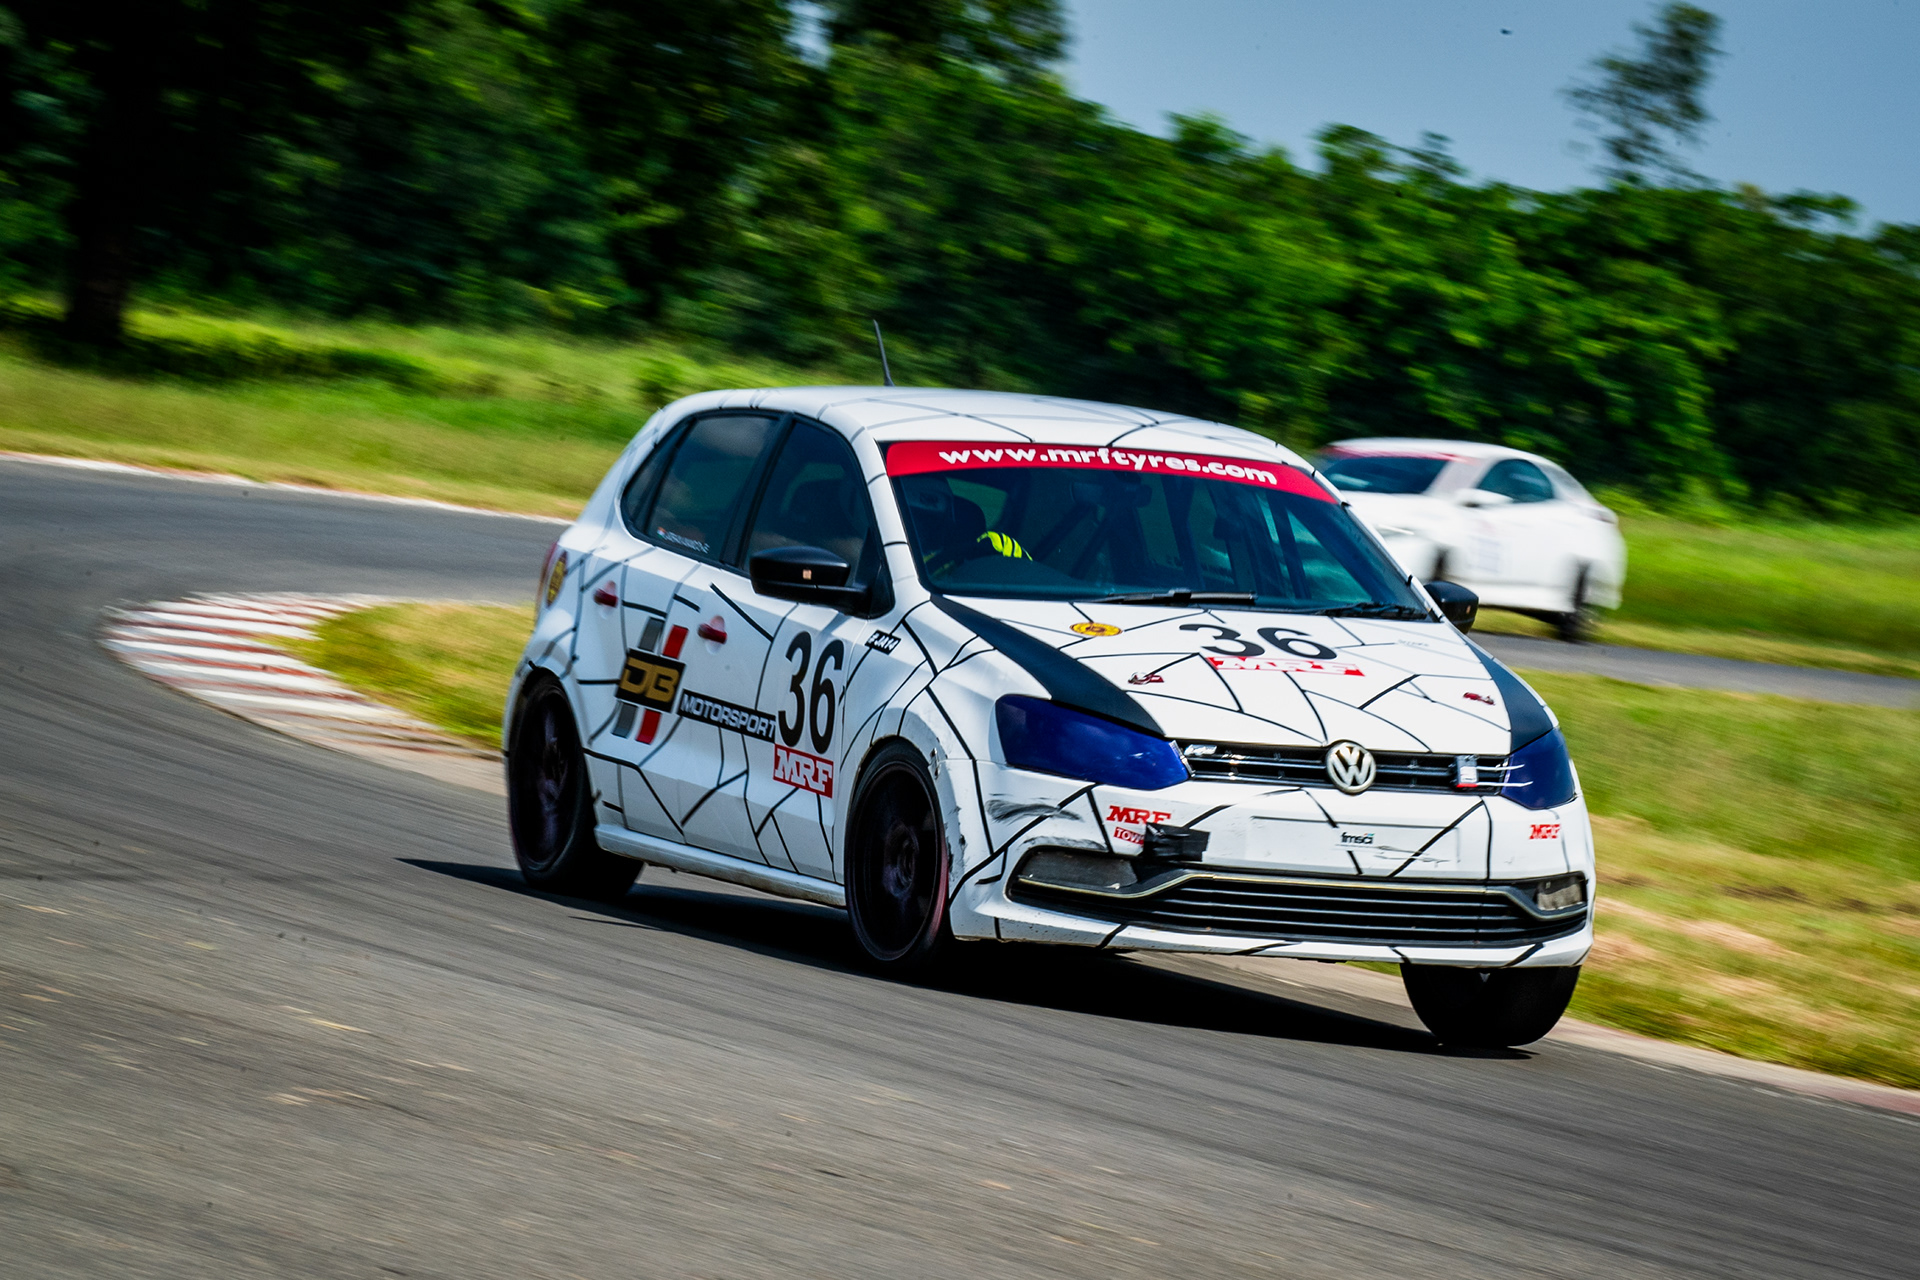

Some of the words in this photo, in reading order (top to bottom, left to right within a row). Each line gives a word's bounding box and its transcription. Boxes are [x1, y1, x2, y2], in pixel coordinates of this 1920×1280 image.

[939, 448, 1278, 485] www.mrftyres.com
[1179, 624, 1338, 660] 36
[778, 631, 845, 754] 36
[681, 693, 777, 738] MOTORSPORT
[775, 748, 833, 793] MRF
[1106, 805, 1171, 825] MRF
